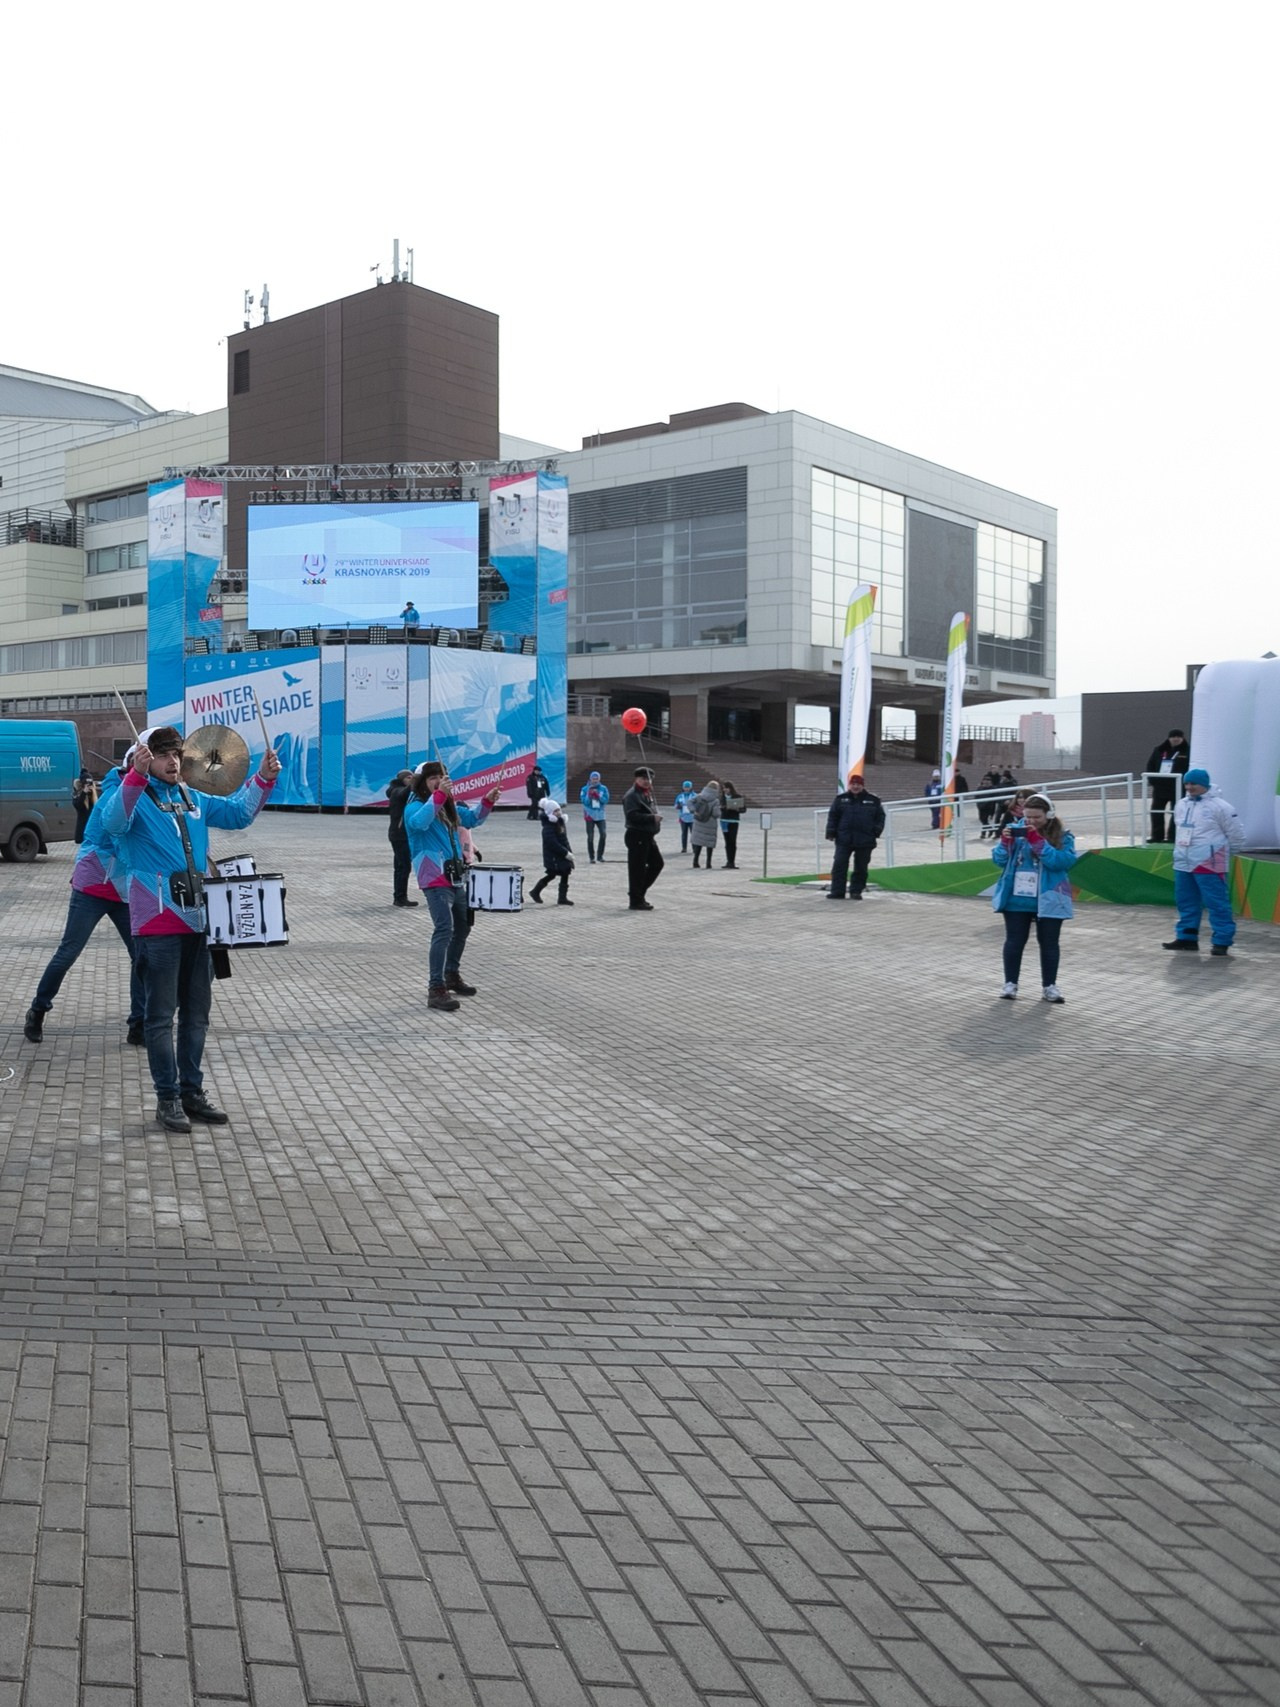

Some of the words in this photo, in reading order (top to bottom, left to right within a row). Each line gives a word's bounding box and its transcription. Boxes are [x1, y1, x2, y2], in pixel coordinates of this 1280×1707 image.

[380, 558, 430, 566] UNIVERSIADE
[334, 568, 407, 577] KRASNOYARSK
[408, 567, 431, 576] 2019
[190, 685, 254, 714] WINTER
[201, 690, 314, 726] UNIVERSIADE
[19, 756, 51, 768] VICTORY
